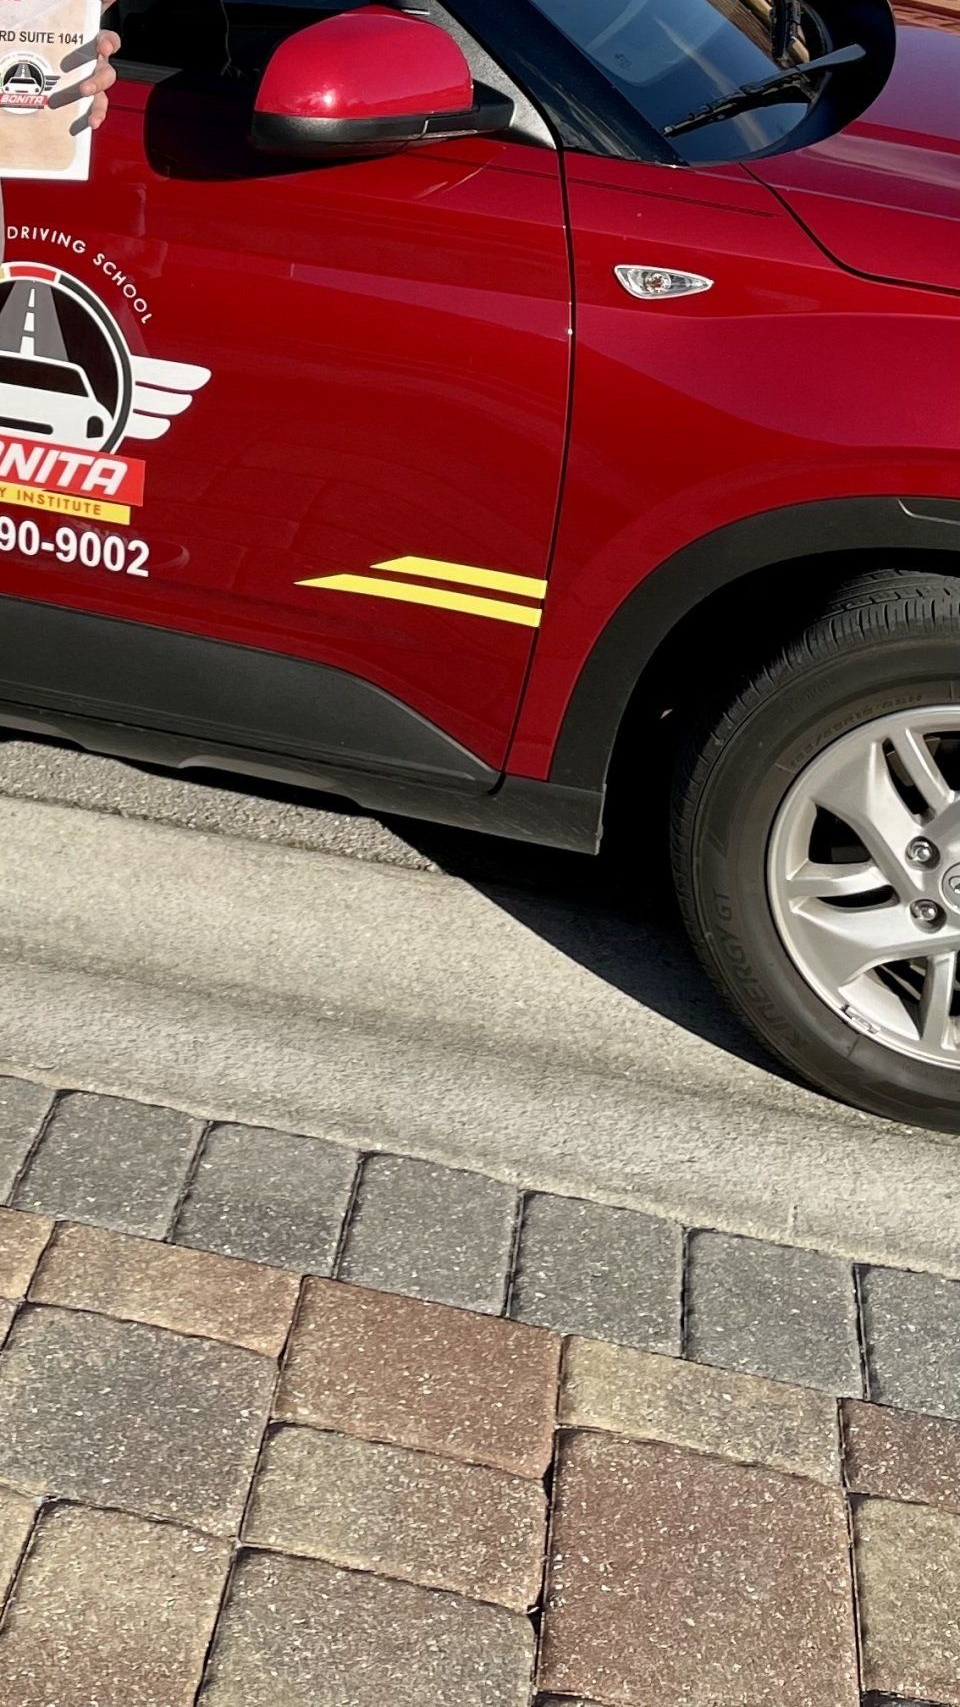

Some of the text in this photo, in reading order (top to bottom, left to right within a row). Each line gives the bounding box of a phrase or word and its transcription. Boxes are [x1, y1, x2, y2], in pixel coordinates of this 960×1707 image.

[0, 30, 16, 43] RD
[19, 31, 55, 44] SUITE
[59, 32, 84, 45] 1041
[0, 94, 43, 104] BONITA
[7, 225, 152, 324] DRIVING SCHOOL
[17, 489, 102, 516] INSTITUTE
